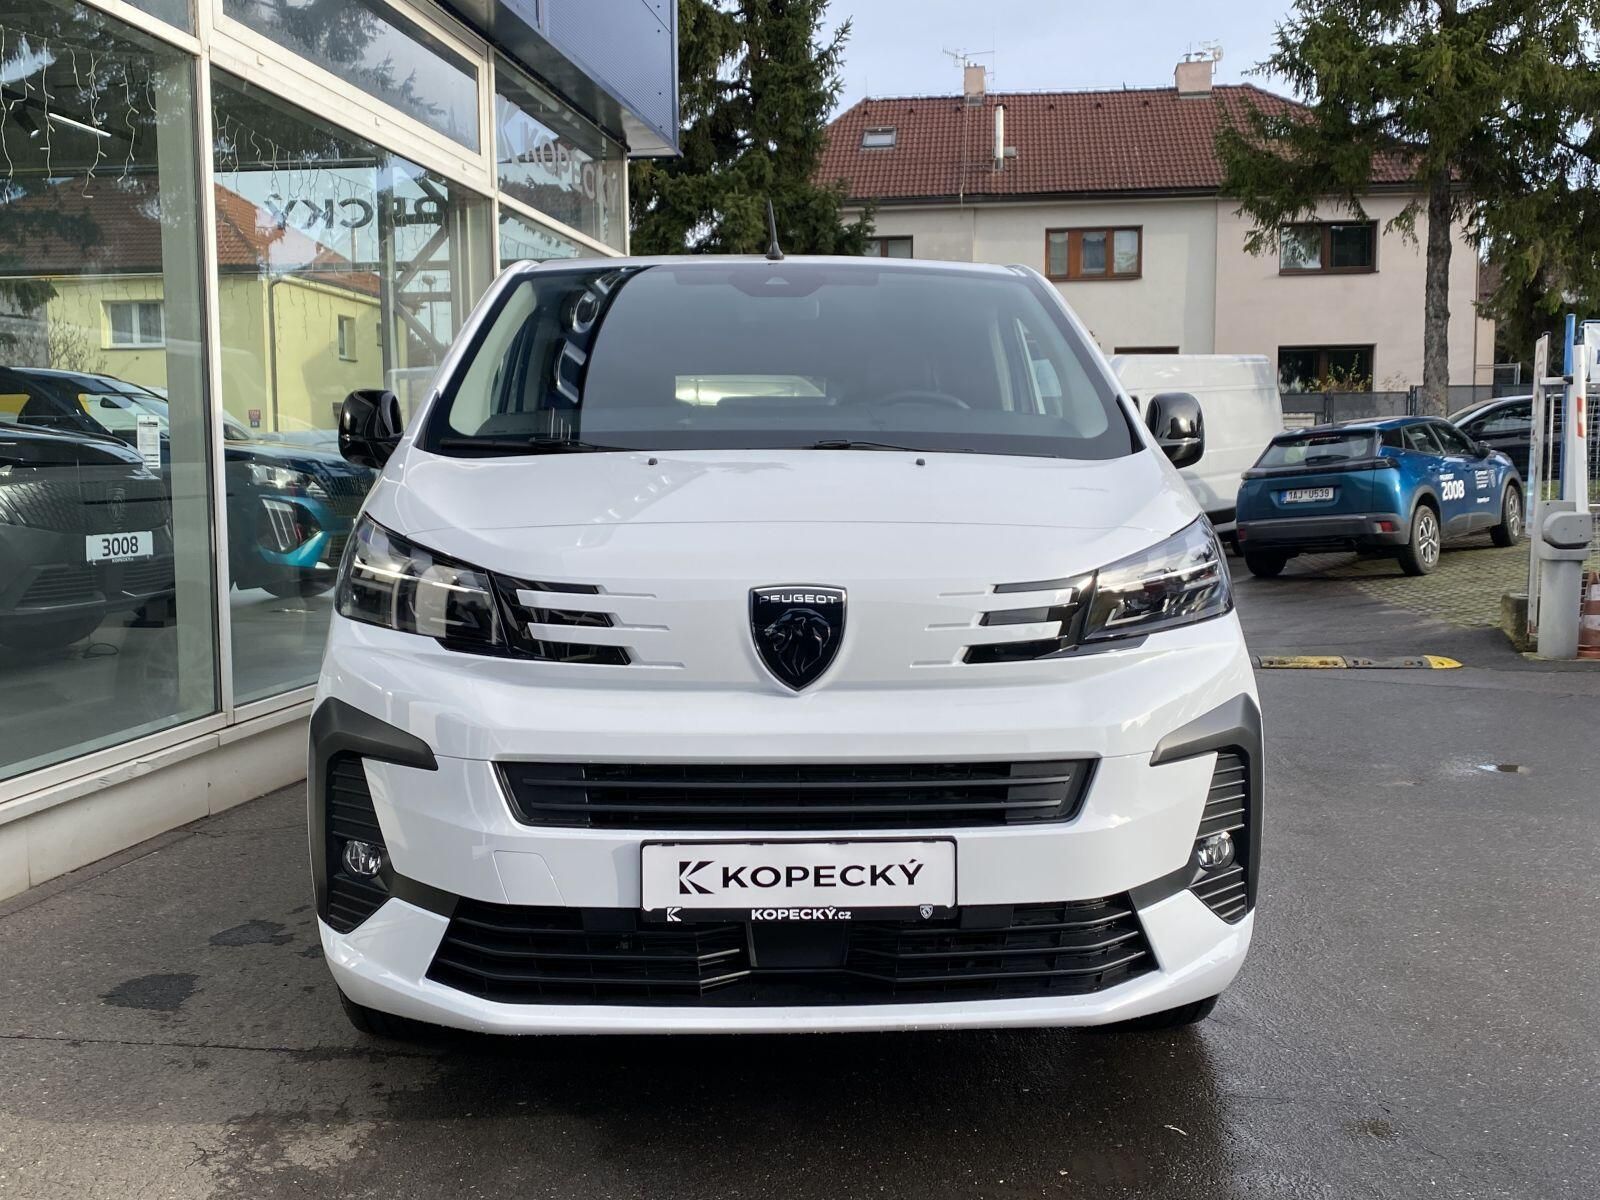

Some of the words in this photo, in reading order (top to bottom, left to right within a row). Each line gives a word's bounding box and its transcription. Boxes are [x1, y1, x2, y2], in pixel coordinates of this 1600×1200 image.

[522, 120, 619, 213] KOPECKÝ
[1289, 490, 1303, 499] 1AJ
[1441, 480, 1465, 501] 2008
[102, 536, 139, 557] 3008
[759, 594, 838, 604] PEUGEOT
[722, 858, 925, 889] KOPECKÝ
[751, 905, 852, 921] KOPECKÝ.cz
